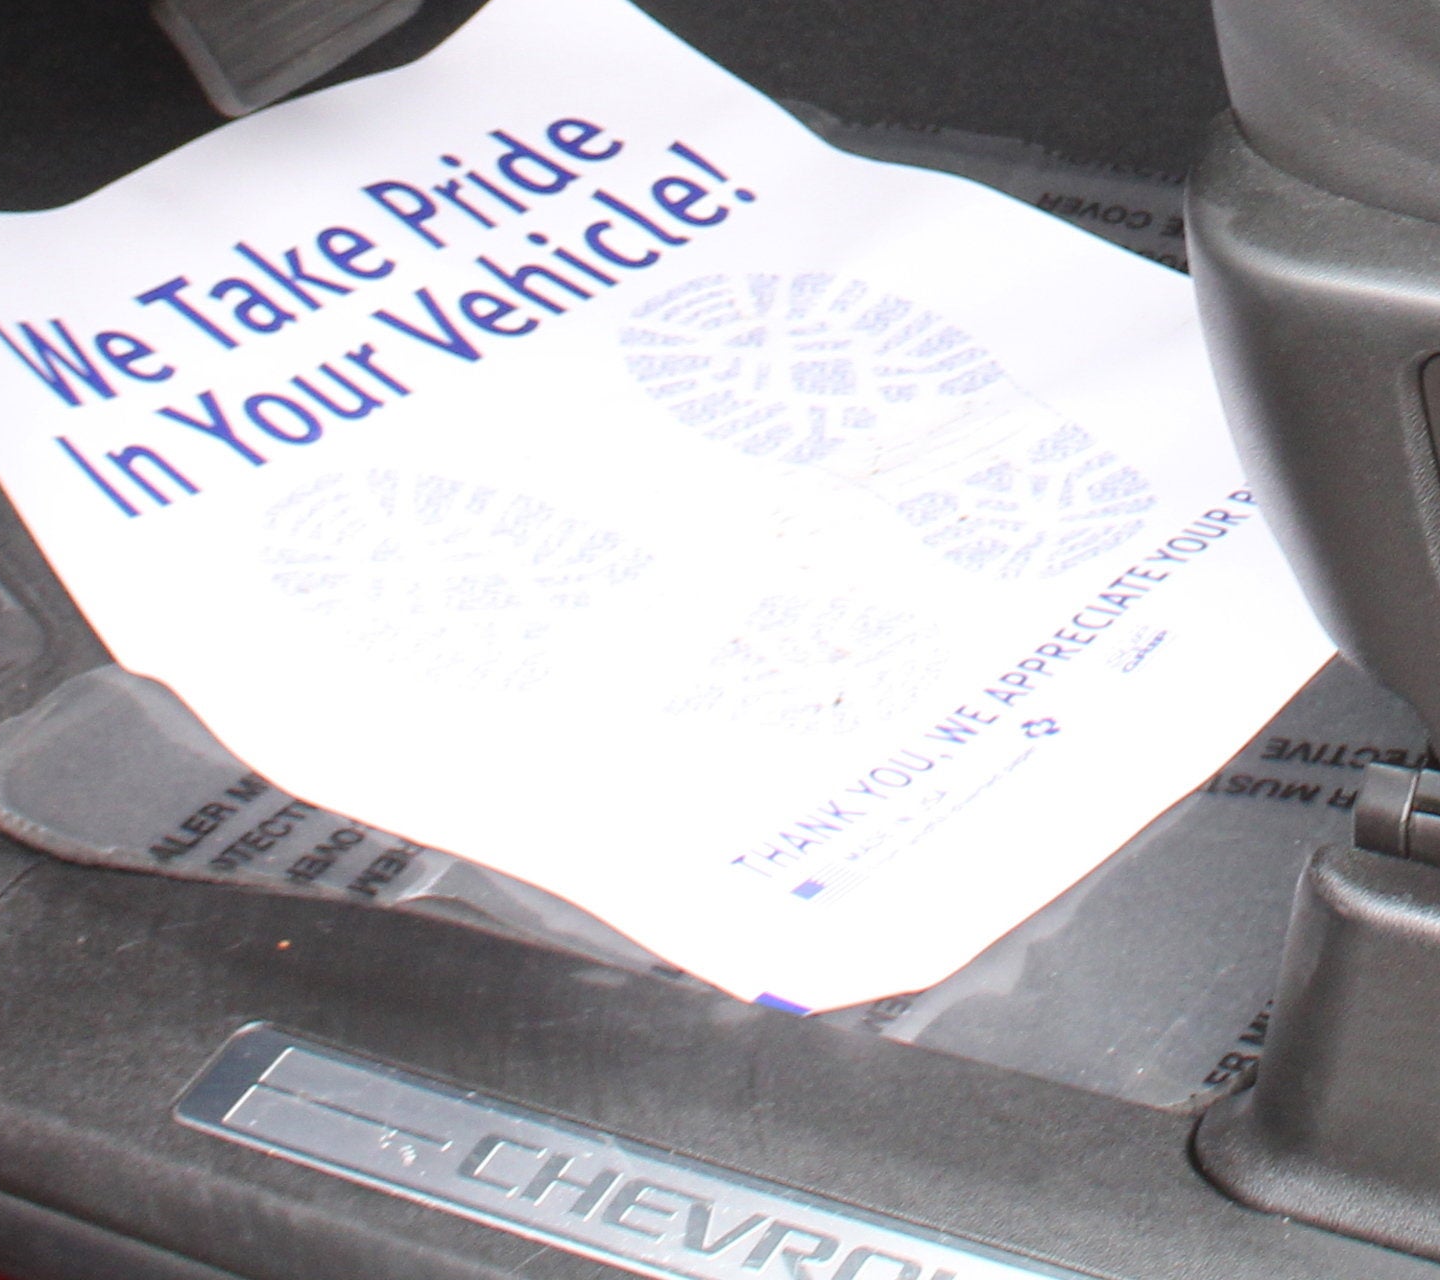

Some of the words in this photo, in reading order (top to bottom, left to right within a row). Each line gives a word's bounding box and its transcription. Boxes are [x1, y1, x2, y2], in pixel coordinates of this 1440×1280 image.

[54, 434, 202, 520] In
[153, 341, 414, 469] Your
[370, 140, 758, 365] Vehicle!
[134, 241, 397, 351] Take
[360, 116, 625, 251] Pride
[730, 798, 867, 879] THANK
[925, 704, 1001, 745] WE
[983, 565, 1170, 707] APPRECIATE
[1144, 507, 1252, 566] YOUR
